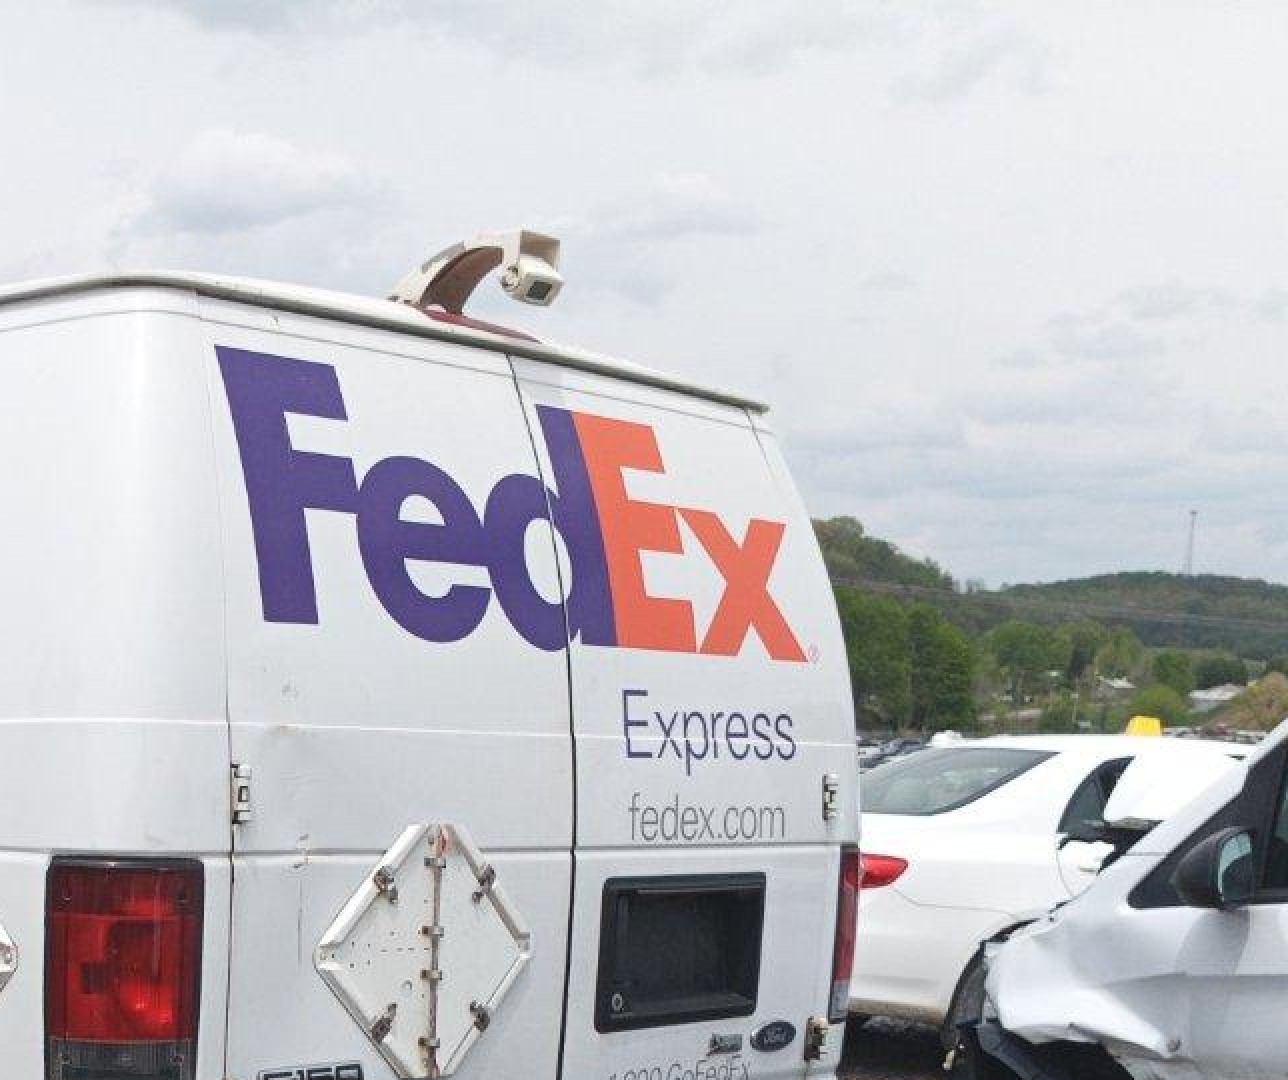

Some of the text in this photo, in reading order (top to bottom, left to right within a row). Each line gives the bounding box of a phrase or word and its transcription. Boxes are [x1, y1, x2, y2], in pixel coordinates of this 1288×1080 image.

[214, 345, 809, 662] FedEx
[622, 689, 798, 776] Express
[628, 793, 785, 843] fedex.com
